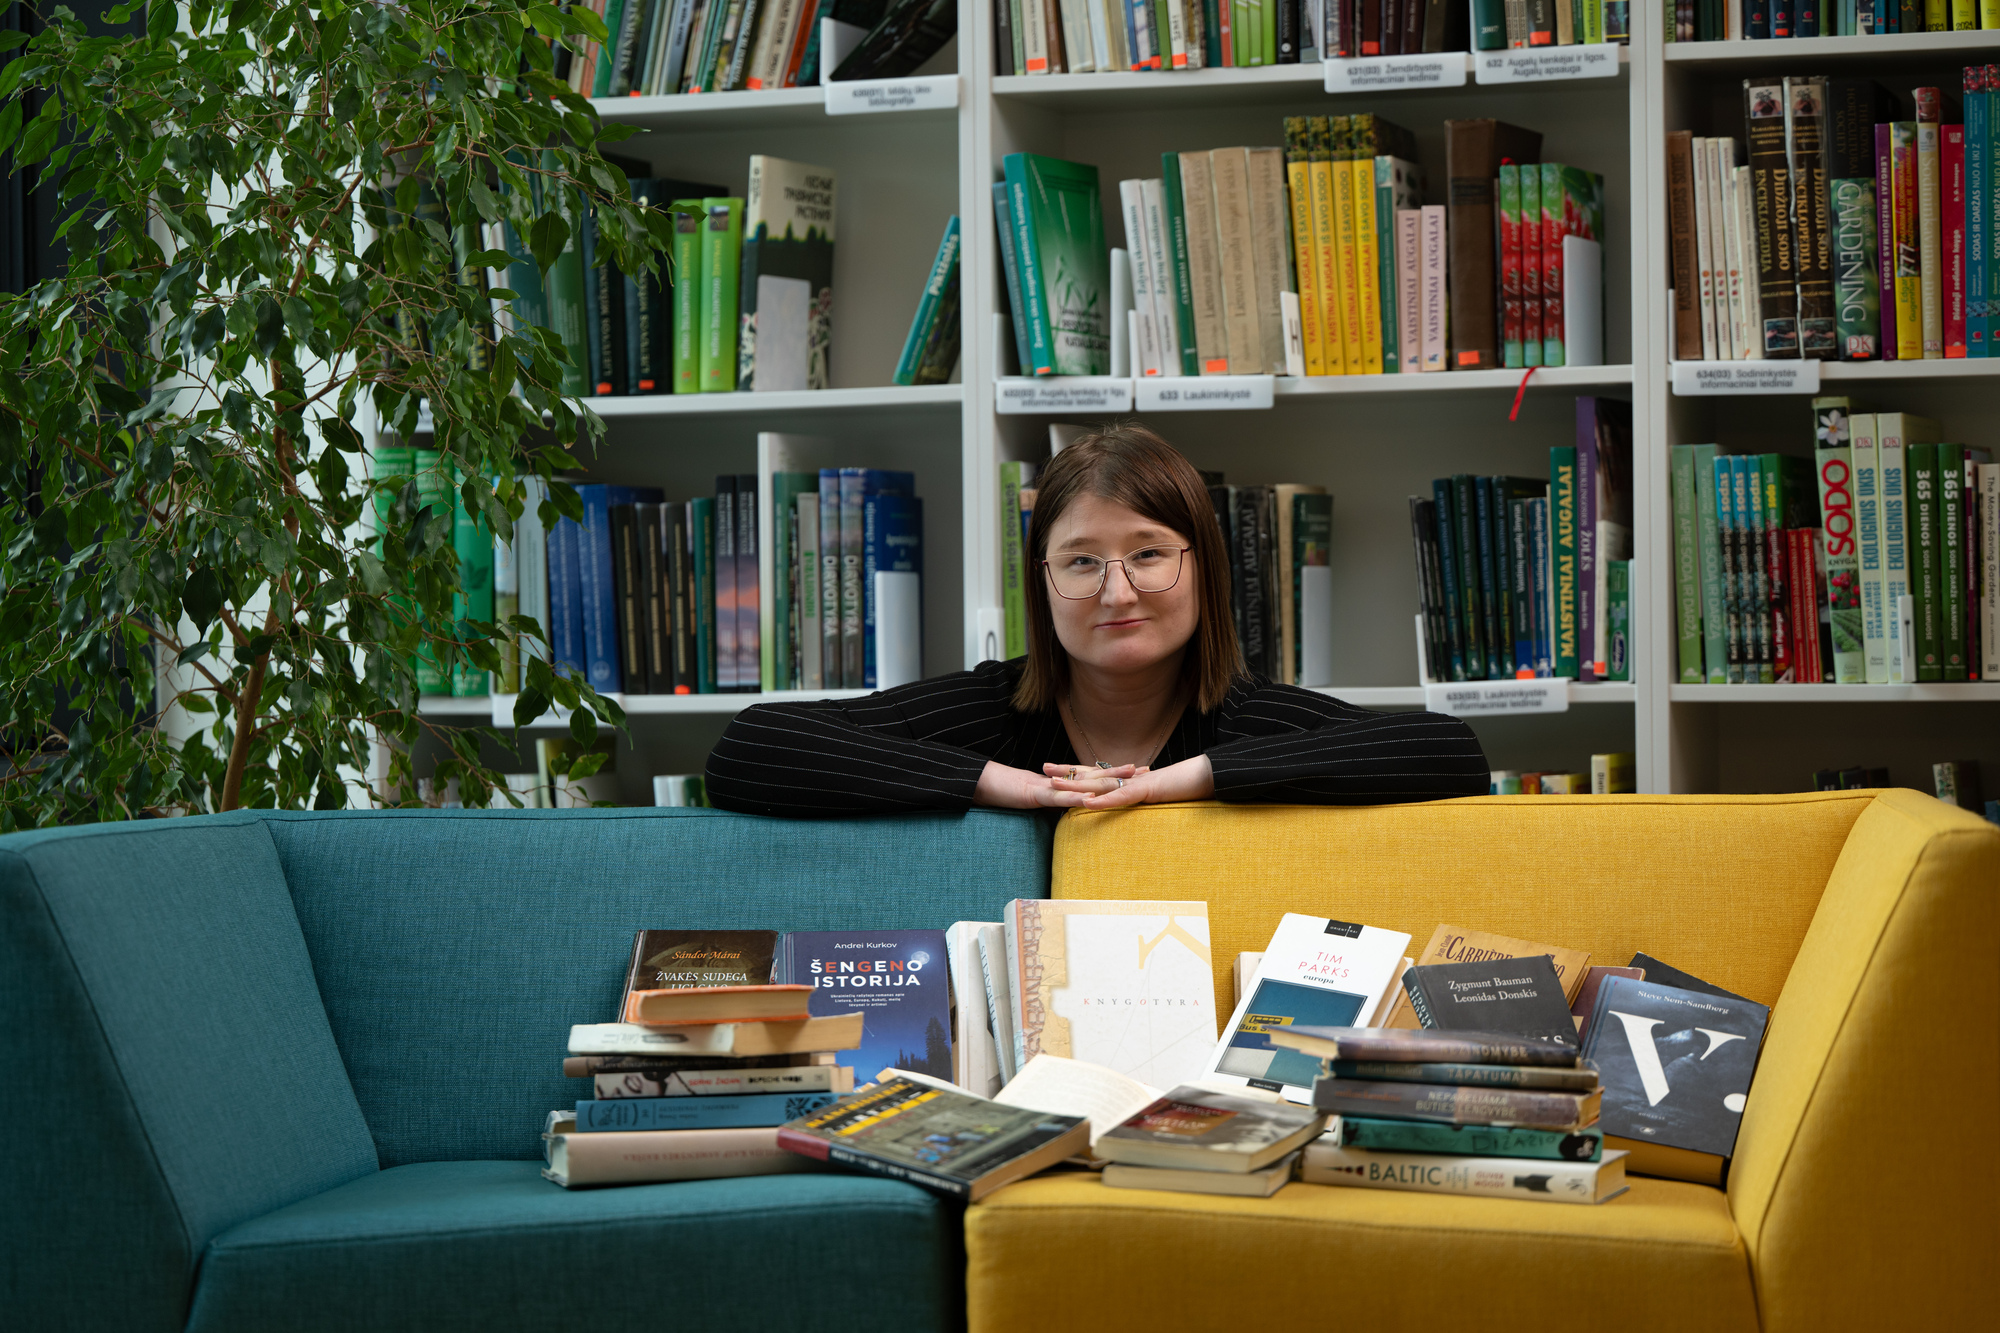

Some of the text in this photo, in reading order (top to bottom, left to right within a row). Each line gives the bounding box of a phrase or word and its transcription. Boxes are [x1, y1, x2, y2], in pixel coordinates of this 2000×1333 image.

[1955, 22, 1975, 31] 2021
[1972, 150, 1980, 161] IKI
[1972, 170, 1980, 188] NUO
[1773, 168, 1790, 270] DIDŽIOJI SODO
[1795, 168, 1811, 272] ENCIKLOPEDIJA
[1813, 168, 1829, 270] DIDŽIOJI SODO
[1970, 190, 1980, 222] DARŽAS
[1672, 152, 1692, 311] KASDIENINIS DARBAS SODE
[1755, 169, 1772, 273] ENCIKLOPEDIJA
[1880, 156, 1892, 290] LENGVAI PRIŽIŪRIMAS SODAS
[1972, 223, 1980, 232] IR
[1317, 171, 1338, 344] VAISTINIAI AUGALAI IŠ SAVO SODO
[1339, 171, 1358, 343] VAISTINIAI AUGALAI IŠ SAVO SODO
[1358, 170, 1374, 342] VAISTINIAI AUGALAI IŠ SAVO SODO
[1837, 182, 1866, 322] GARDENING
[1921, 157, 1937, 330] Sodininkavimo menas
[1972, 234, 1981, 261] SODAS
[1294, 172, 1317, 344] VAISTINIAI AUGALAI IŠ SAVO SODO
[1900, 243, 1915, 275] 777
[1405, 217, 1418, 344] VAISTINIAI AUGALAI
[1428, 214, 1439, 342] VAISTINIAI AUGALAI
[1952, 229, 1962, 321] Didžioji sodininko knyga
[1900, 279, 1908, 303] Edgar
[1847, 338, 1873, 352] DK
[1700, 377, 1793, 390] informaciniai leidiniai
[1735, 367, 1797, 380] Sodininkystės
[1855, 436, 1873, 448] DK
[1882, 436, 1901, 448] DK
[1820, 458, 1856, 557] SODO
[1856, 468, 1879, 570] EKOLOGINIS ŪKIS
[1884, 468, 1905, 570] EKOLOGINIS ŪKIS
[1580, 530, 1592, 571] ŽOLĖS
[1916, 469, 1933, 640] 365 DIENOS SODE DARŽE NAMUOSE
[1944, 469, 1959, 640] 365 DIENOS SODE DARŽE NAMUOSE
[1986, 476, 1998, 608] The Money-Saving Gardener
[1557, 465, 1575, 657] MAISTINIAI AUGALAI
[1827, 557, 1858, 567] KNYGA
[1680, 517, 1696, 640] APIE SODĄ IR DARŽĄ
[1705, 517, 1720, 640] APIE SODĄ IR DARŽĄ
[823, 555, 838, 637] DIRVOTYRA
[844, 555, 858, 637] DIRVOTYRA
[1863, 581, 1873, 609] JAMES
[1887, 581, 1897, 609] JAMES
[1871, 581, 1883, 639] STRAWBRIDGE
[1867, 620, 1875, 639] DICK
[1889, 620, 1898, 639] DICK
[672, 950, 742, 960] Sándor Márai
[834, 942, 897, 950] Andrei Kurkov
[1316, 951, 1343, 964] TIM
[656, 970, 748, 982] ŽVAKĖS SUDEGA
[810, 958, 923, 974] ŠENGENO
[1298, 961, 1350, 979] PARKS
[1303, 974, 1335, 985] europa
[814, 974, 921, 988] ISTORIJA
[1448, 976, 1534, 993] Zygmunt Bauman
[1083, 998, 1200, 1008] KNYGOTYRA
[1453, 988, 1538, 1004] Leonidas Donskis
[1637, 989, 1730, 1015] Steve Sem-Sandberg
[1240, 1023, 1257, 1032] Bus
[1447, 1067, 1529, 1083] TAPATUMAS
[1368, 1161, 1442, 1186] BALTIC
